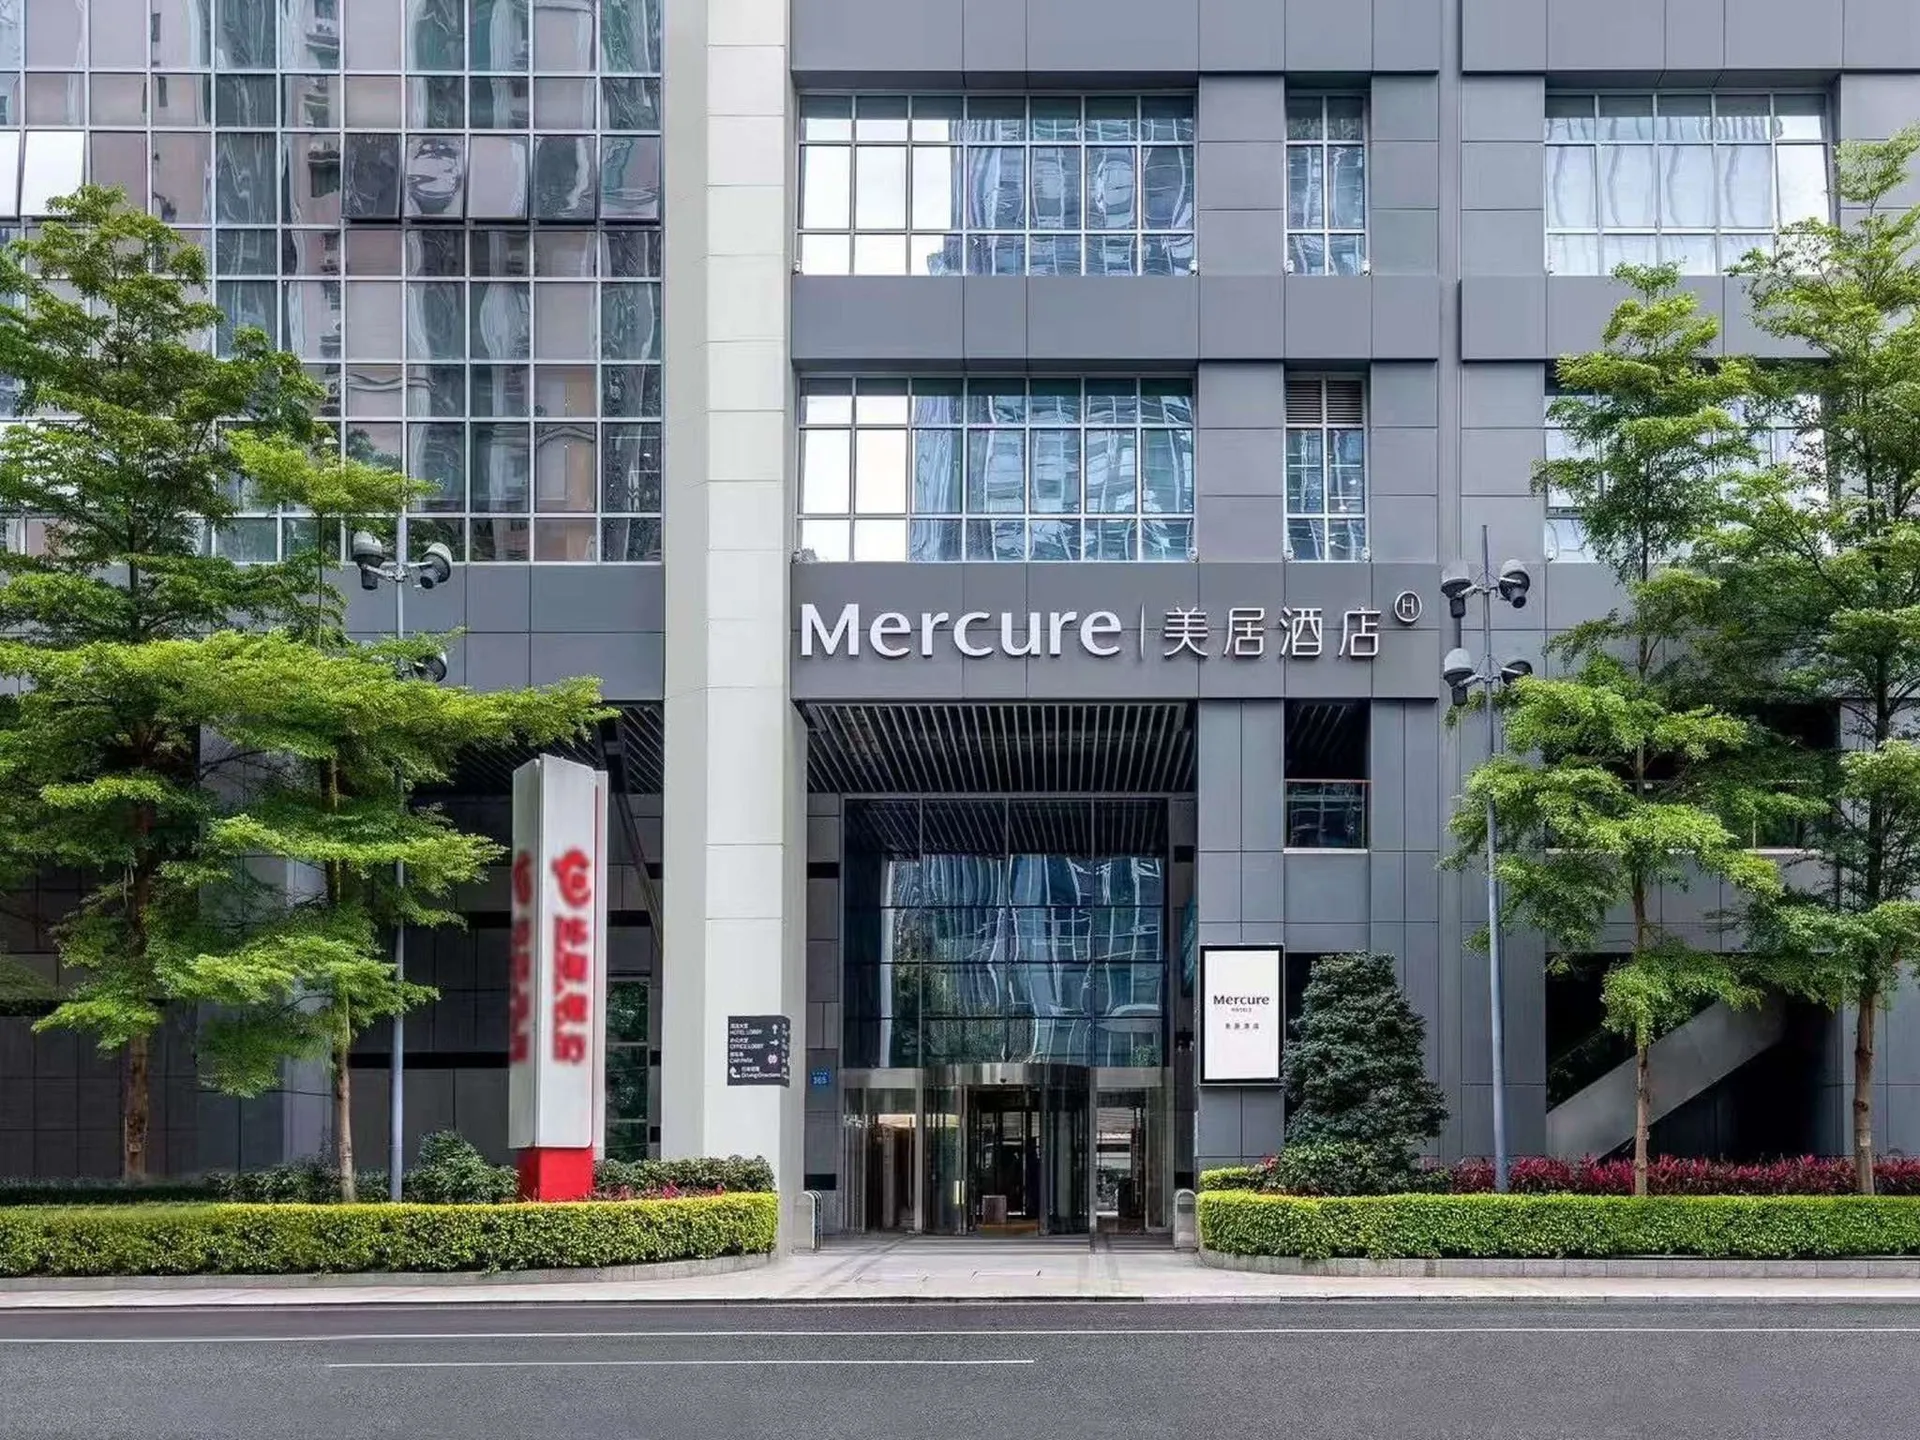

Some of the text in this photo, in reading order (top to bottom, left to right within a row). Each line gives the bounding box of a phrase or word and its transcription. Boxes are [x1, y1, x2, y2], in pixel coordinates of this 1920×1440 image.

[801, 603, 1122, 656] Mercure
[1164, 606, 1381, 657] 美居酒店
[1213, 994, 1270, 1005] Mercure
